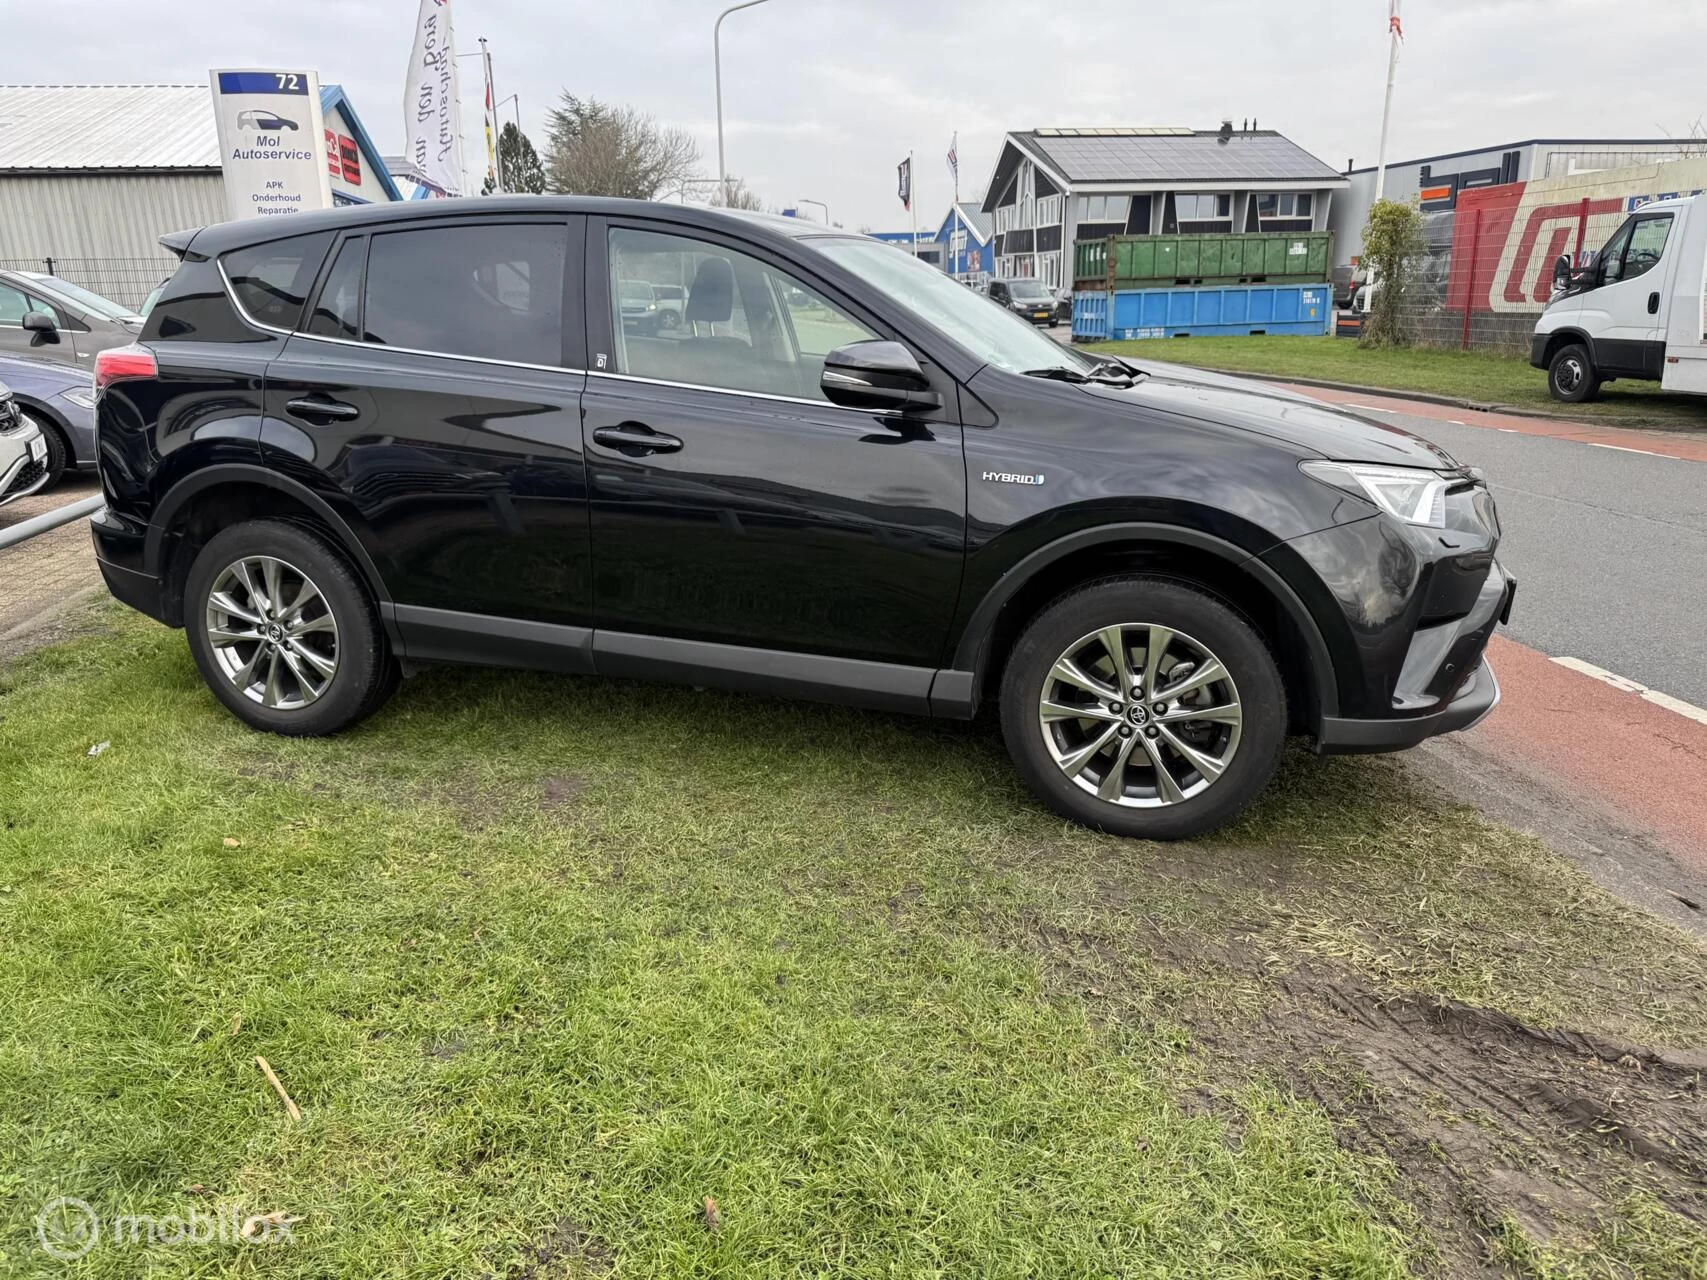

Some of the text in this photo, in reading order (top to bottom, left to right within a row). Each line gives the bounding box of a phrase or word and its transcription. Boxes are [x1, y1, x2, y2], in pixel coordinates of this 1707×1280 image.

[276, 74, 300, 90] 72
[256, 135, 281, 147] Mol
[233, 147, 312, 160] Autoservice
[265, 181, 284, 189] APK
[252, 193, 302, 202] Onderhoud
[257, 205, 299, 216] Reparatie
[982, 471, 1035, 485] HYBRID
